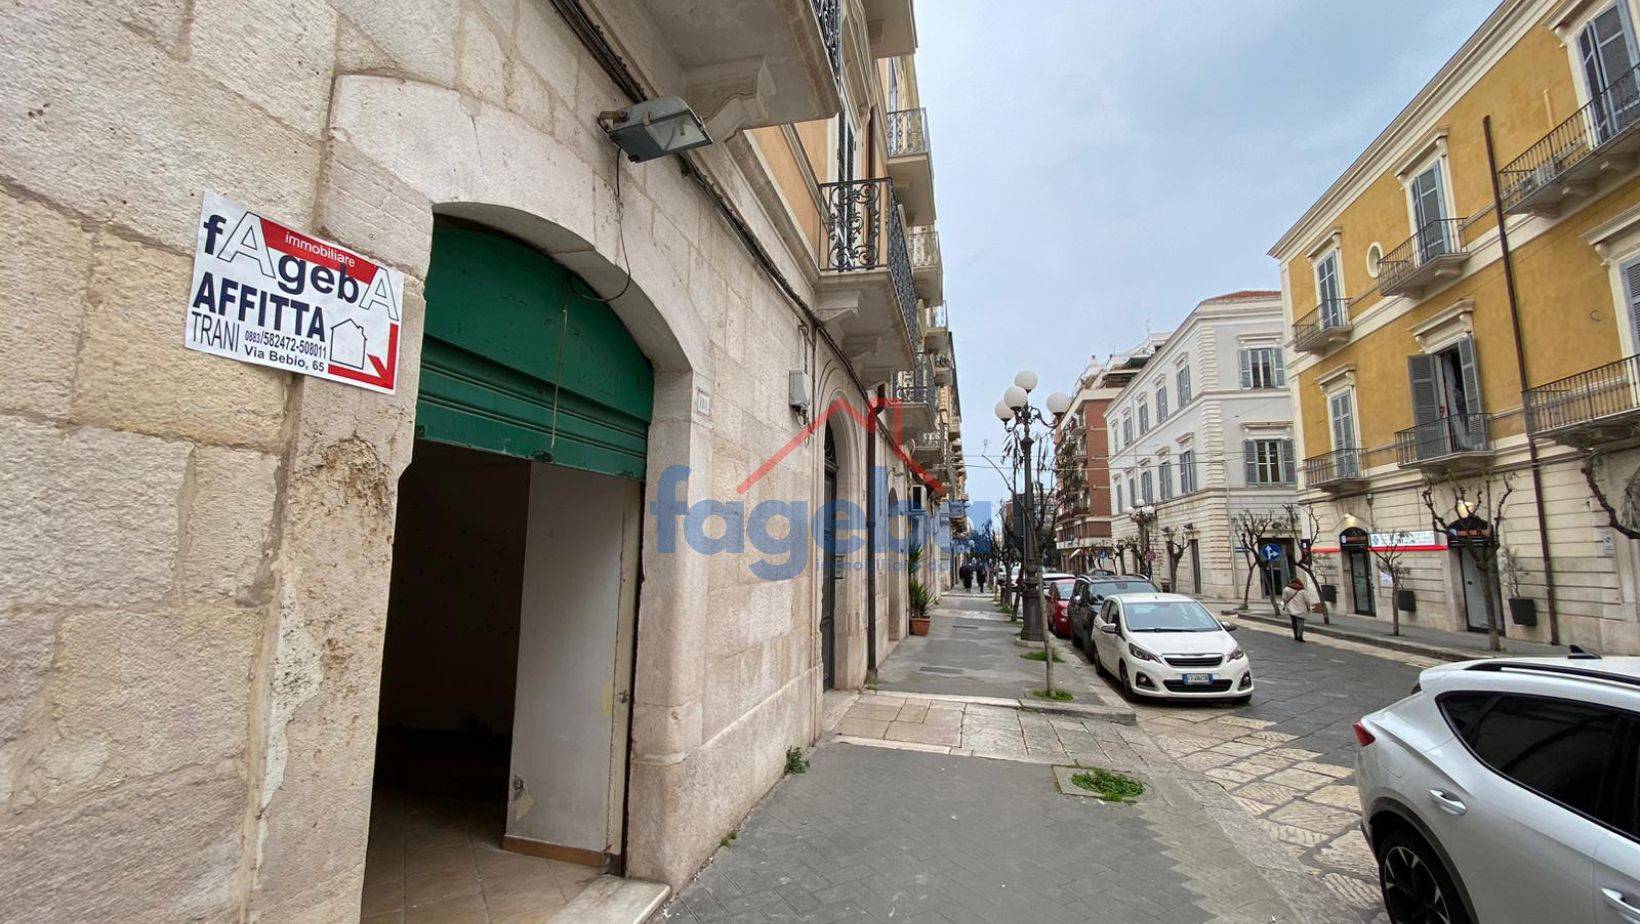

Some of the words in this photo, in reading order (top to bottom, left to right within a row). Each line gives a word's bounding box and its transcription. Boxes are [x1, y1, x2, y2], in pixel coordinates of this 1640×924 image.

[285, 232, 355, 267] immobiliare
[193, 272, 325, 342] AFFITTA
[191, 311, 239, 352] TRANI
[245, 330, 326, 359] 0883/582472-508011
[245, 345, 264, 359] Via
[269, 350, 308, 369] Bebio,
[312, 361, 324, 372] 65
